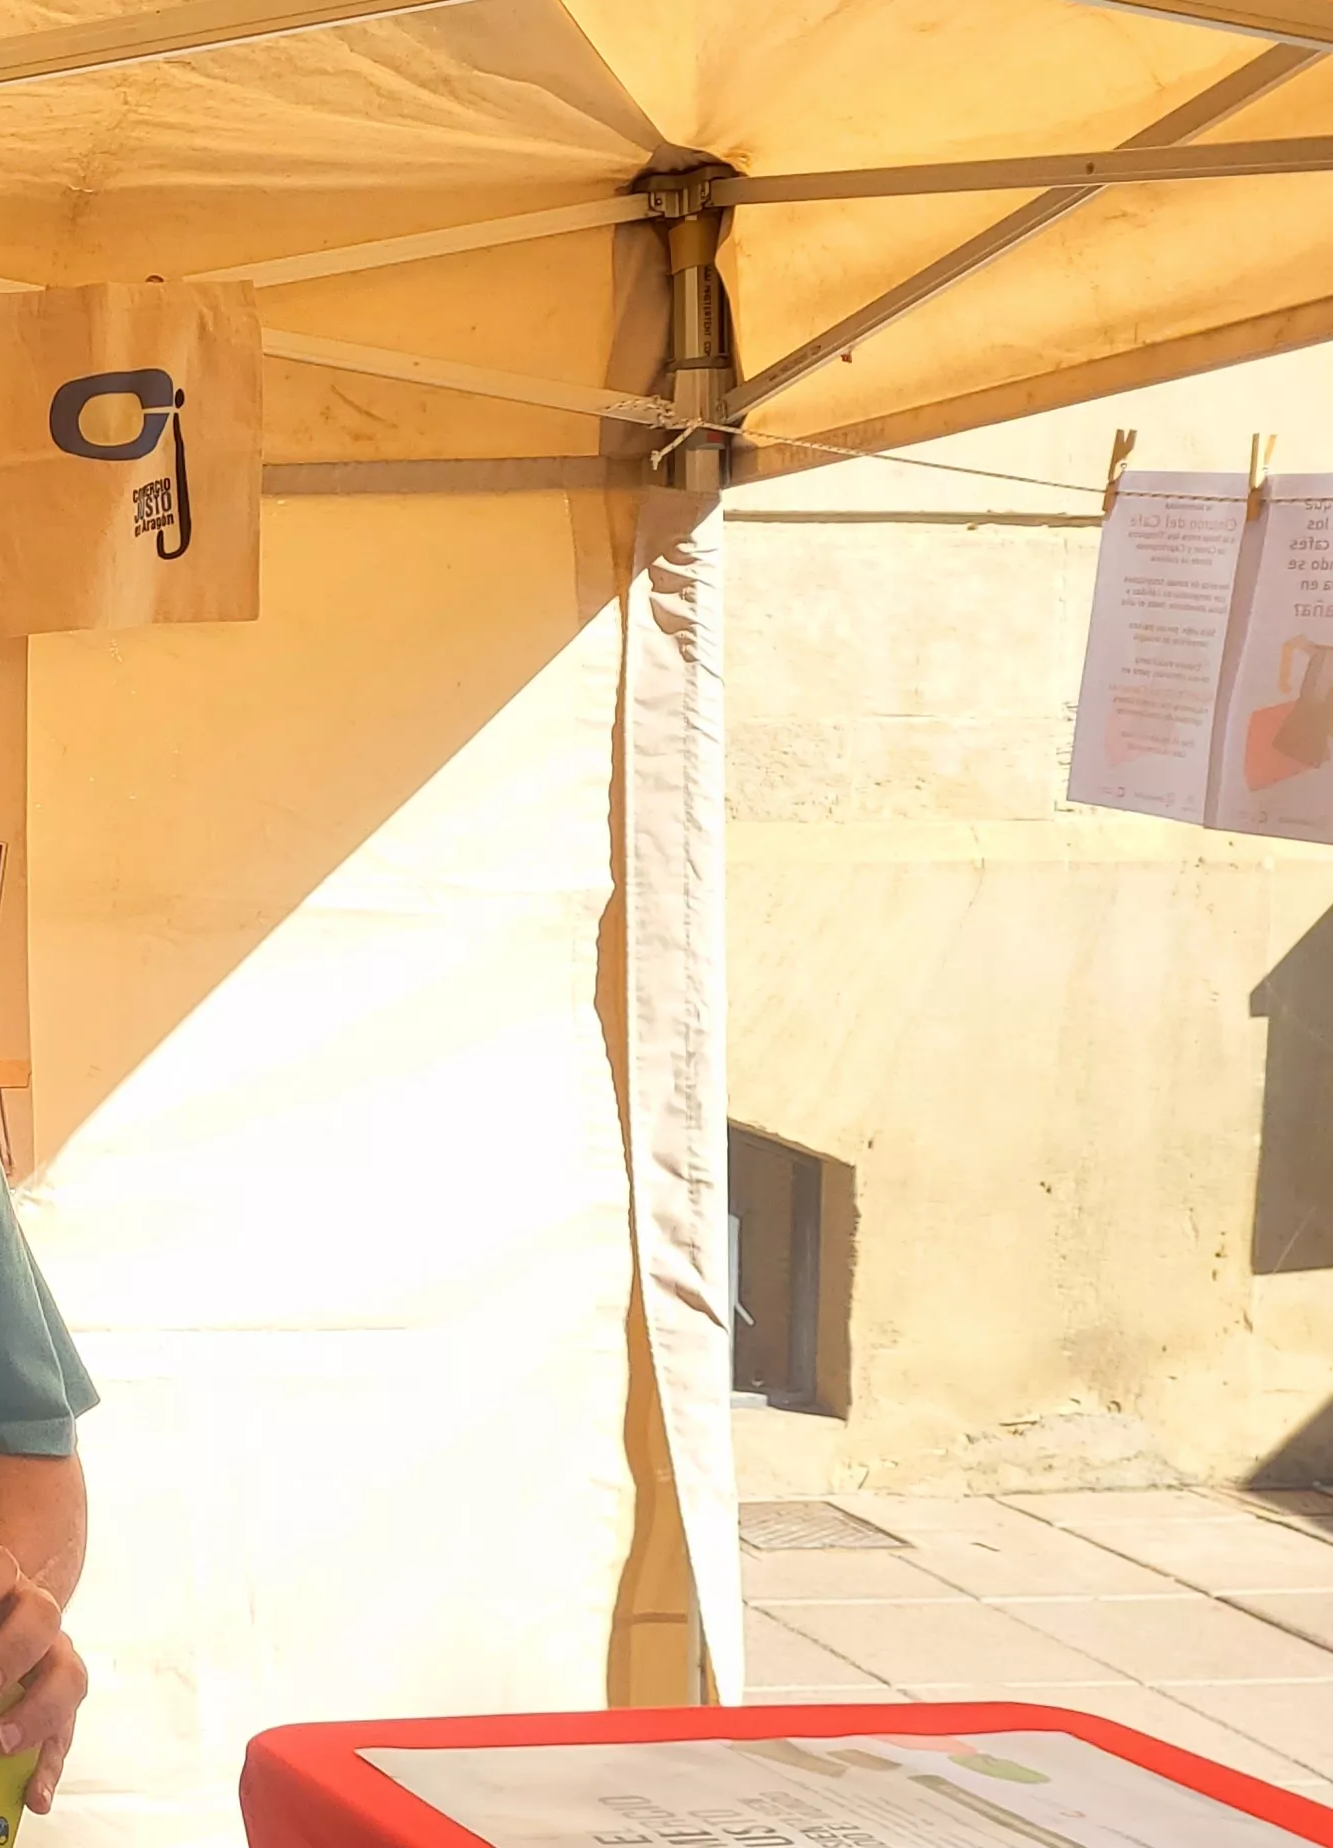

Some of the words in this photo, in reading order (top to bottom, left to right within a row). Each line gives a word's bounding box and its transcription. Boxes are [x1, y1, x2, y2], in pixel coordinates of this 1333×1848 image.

[133, 491, 172, 523] JUSTO
[598, 1795, 727, 1848] MERCIO
[686, 1808, 795, 1848] USTO
